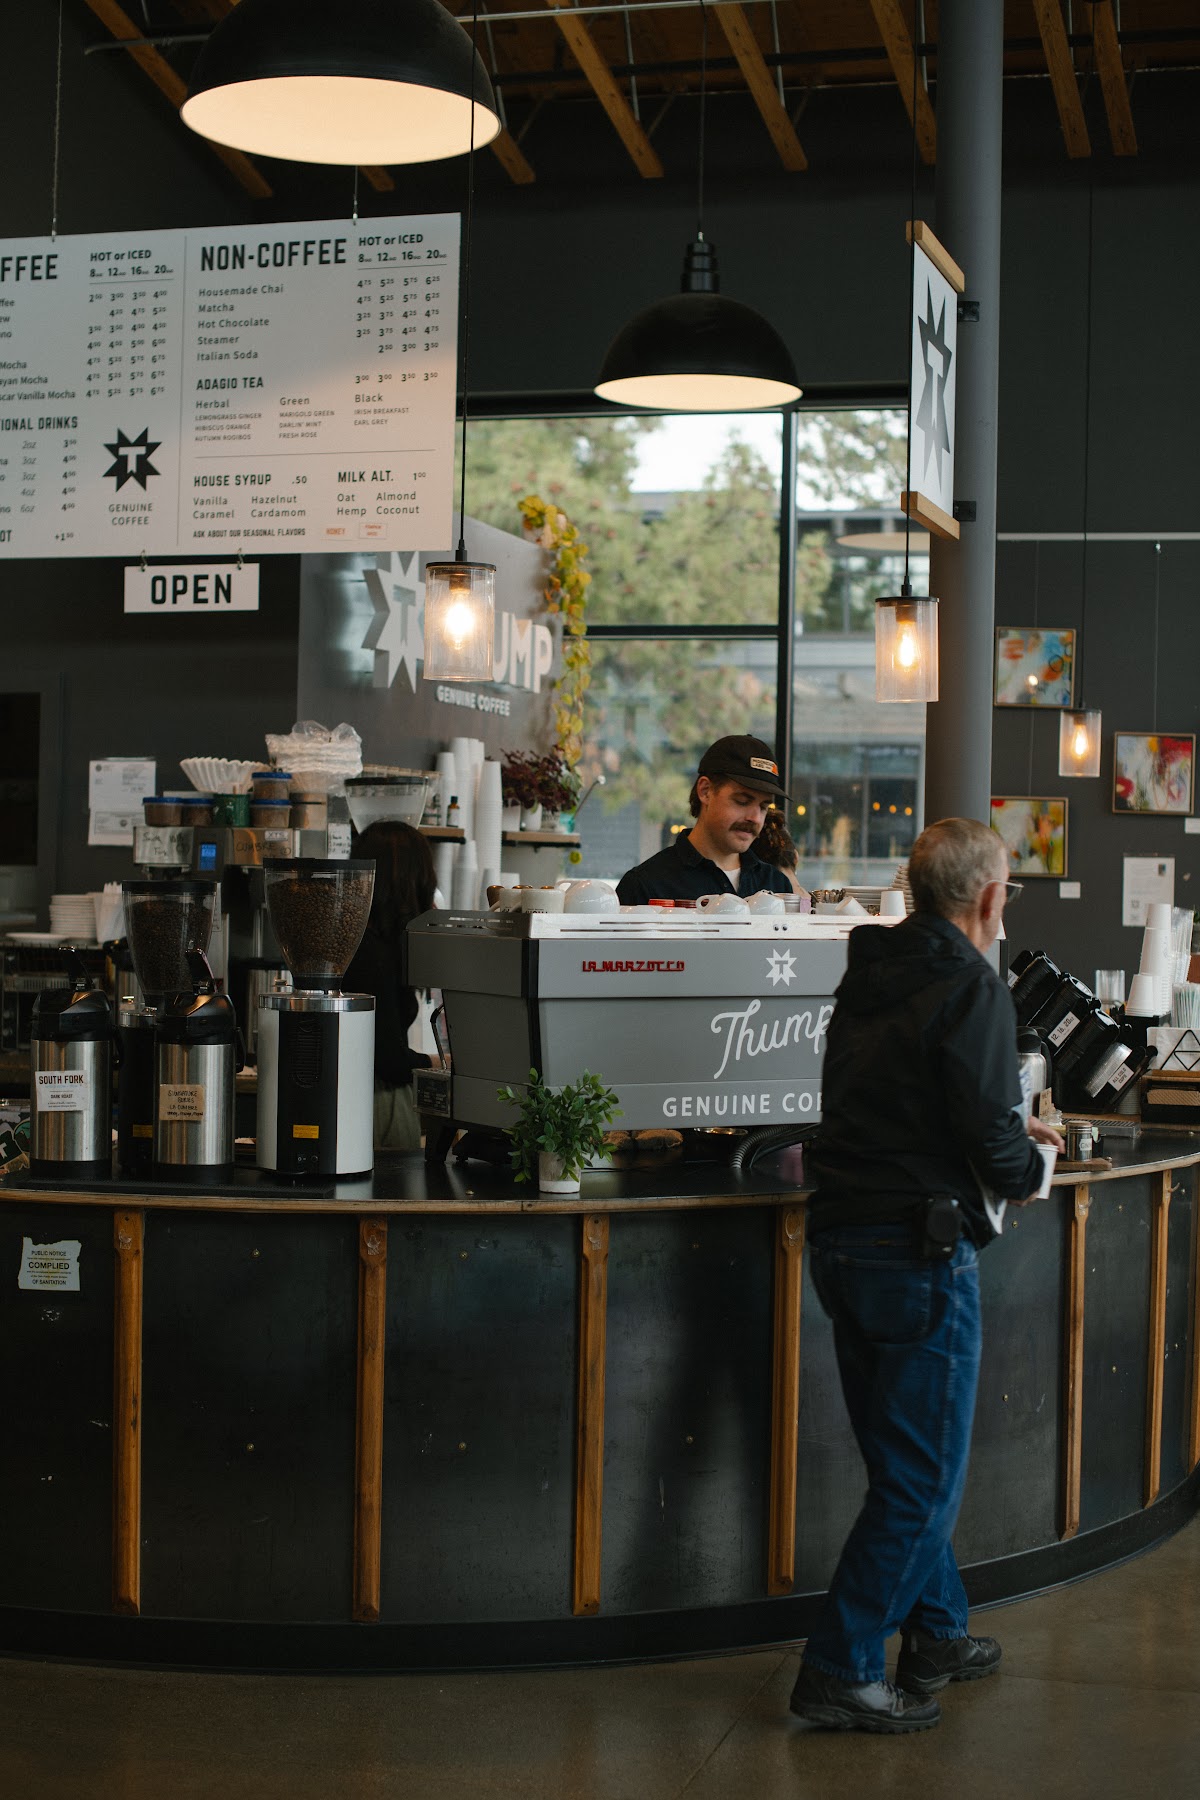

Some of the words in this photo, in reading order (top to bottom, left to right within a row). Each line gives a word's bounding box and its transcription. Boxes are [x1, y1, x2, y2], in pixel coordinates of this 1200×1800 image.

[358, 236, 382, 246] HOT
[398, 234, 424, 244] ICED
[90, 252, 112, 262] HOT
[128, 250, 152, 259] ICED
[201, 238, 347, 271] NON-COFFEE
[199, 286, 258, 297] Housemade
[261, 284, 284, 294] Chai
[198, 303, 235, 312] Matcha
[198, 319, 216, 328] Hot
[218, 317, 270, 328] Chocolate
[198, 336, 240, 345] Steamer
[196, 351, 230, 361] Italian
[233, 350, 258, 360] Soda
[20, 376, 48, 384] Mocha
[196, 378, 238, 390] ADAGIO
[242, 376, 264, 388] TEA
[48, 390, 76, 400] Mocha
[354, 394, 384, 402] Black
[196, 399, 230, 408] Herbal
[280, 397, 310, 406] Green
[38, 416, 78, 430] DRINKS
[194, 474, 230, 487] HOUSE
[234, 474, 272, 486] SYRUP
[292, 476, 308, 484] .50
[338, 471, 366, 482] MILK
[371, 470, 394, 482] ALT.
[192, 496, 228, 506] Vanilla
[252, 494, 298, 504] Hazelnut
[337, 493, 356, 502] Oat
[376, 491, 416, 500] Almond
[108, 503, 153, 513] GENUINE
[192, 510, 234, 519] Caramel
[250, 508, 306, 518] Cardamom
[337, 507, 366, 516] Hemp
[376, 506, 420, 514] Coconut
[112, 516, 150, 526] COFFEE
[192, 530, 206, 538] ASK
[207, 529, 228, 538] ABOUT
[229, 528, 242, 537] OUR
[242, 528, 275, 537] SEASONAL
[277, 528, 306, 536] FLAVORS
[151, 574, 232, 604] OPEN
[436, 685, 476, 709] GENUINE
[477, 694, 510, 717] COFFEE
[602, 960, 684, 972] MARZOCCO
[710, 999, 834, 1080] Thump
[38, 1076, 62, 1084] SOUTH
[64, 1074, 84, 1084] FORK
[662, 1094, 771, 1118] GENUINE
[28, 1262, 70, 1270] COMPLIED
